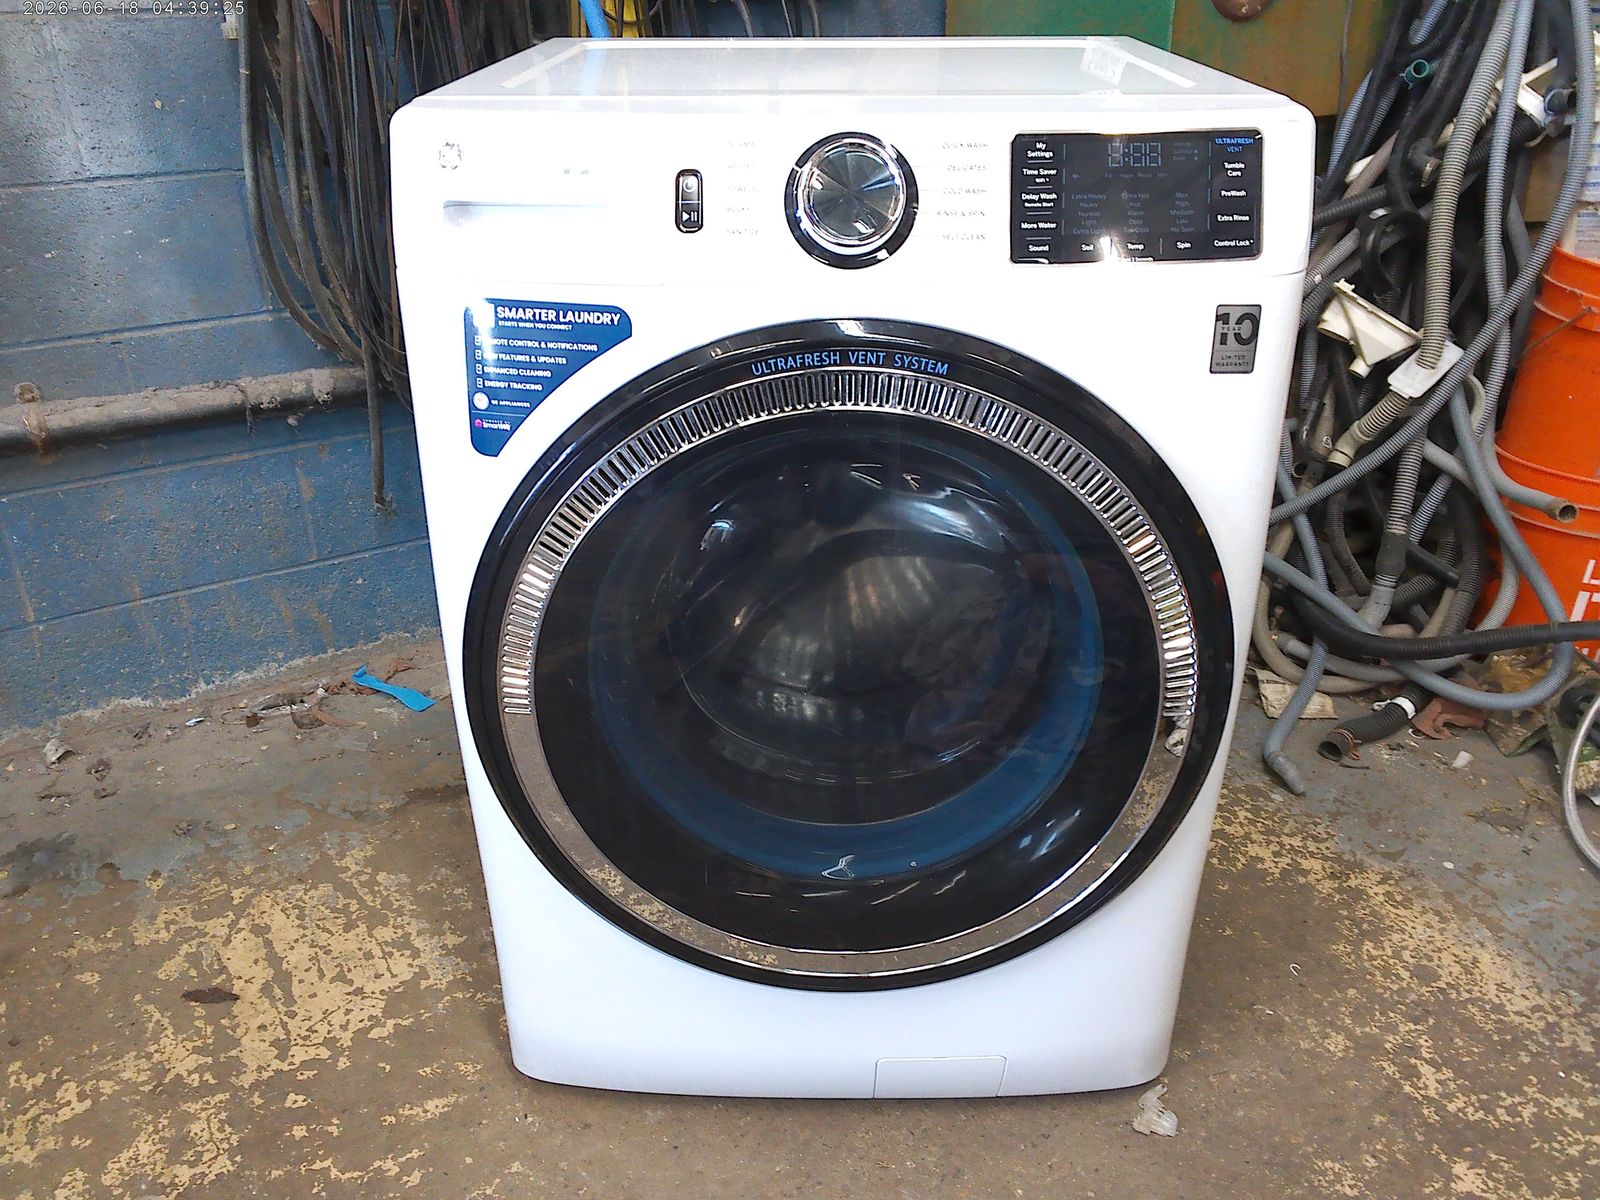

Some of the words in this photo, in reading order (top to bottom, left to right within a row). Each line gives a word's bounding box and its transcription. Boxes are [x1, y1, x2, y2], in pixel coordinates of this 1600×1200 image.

[1215, 137, 1254, 145] ULTRAFRESH
[1036, 142, 1047, 151] My
[1027, 150, 1054, 158] Settings
[1022, 168, 1039, 176] Time
[1039, 168, 1058, 176] Saver
[1021, 193, 1039, 202] Delay
[1217, 214, 1233, 222] Extra
[1126, 242, 1145, 251] Temp
[1176, 241, 1192, 250] Spin
[1214, 239, 1236, 247] Control
[1236, 239, 1250, 247] Lock
[1028, 244, 1050, 252] Sound
[496, 306, 557, 321] SMARTER
[559, 310, 621, 325] LAUNDRY
[498, 320, 518, 328] STARTS
[518, 321, 534, 329] WHEN
[535, 322, 546, 330] YOU
[546, 323, 572, 331] CONNECT
[1216, 312, 1260, 346] 10
[508, 339, 540, 349] CONTROL
[540, 341, 546, 349] &
[547, 341, 598, 352] NOTIFICATIONS
[498, 353, 530, 363] FEATURES
[530, 355, 536, 363] &
[537, 356, 567, 366] UPDATES
[751, 351, 840, 376] ULTRAFRESH
[848, 351, 886, 366] VENT
[893, 354, 949, 377] SYSTEM
[484, 366, 518, 377] ENHANCED
[518, 368, 552, 378] CLEANING
[484, 380, 509, 390] ENERGY
[510, 381, 544, 392] TRACKING
